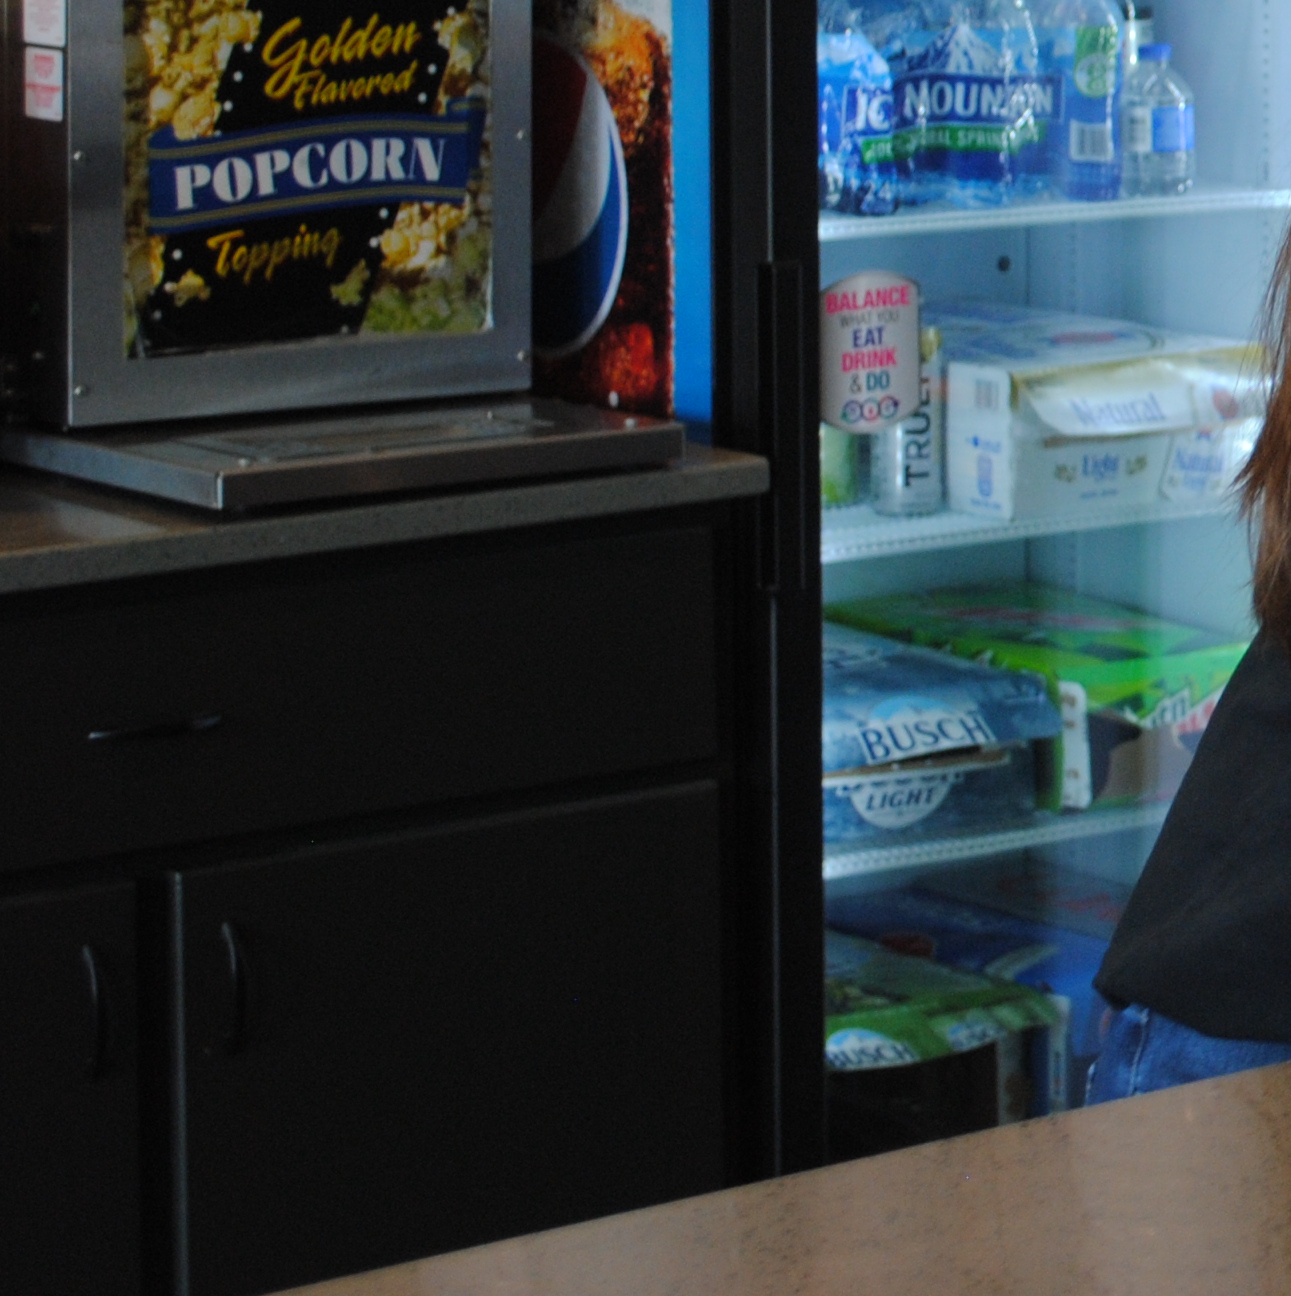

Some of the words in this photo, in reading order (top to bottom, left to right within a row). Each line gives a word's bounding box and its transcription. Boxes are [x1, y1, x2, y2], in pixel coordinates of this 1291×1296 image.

[262, 12, 422, 99] Golden
[294, 59, 418, 111] Flavored
[174, 137, 446, 211] POPCORN
[206, 223, 340, 284] Topping
[825, 284, 911, 314] BALANCE
[840, 312, 872, 328] WHAT
[877, 309, 899, 323] YOU
[852, 325, 885, 349] EAT
[842, 347, 897, 372] DRINK
[850, 374, 862, 393] &
[866, 370, 890, 390] DO
[1070, 391, 1167, 426] Natural
[857, 709, 991, 762] BUSCH
[865, 787, 935, 811] LIGHT
